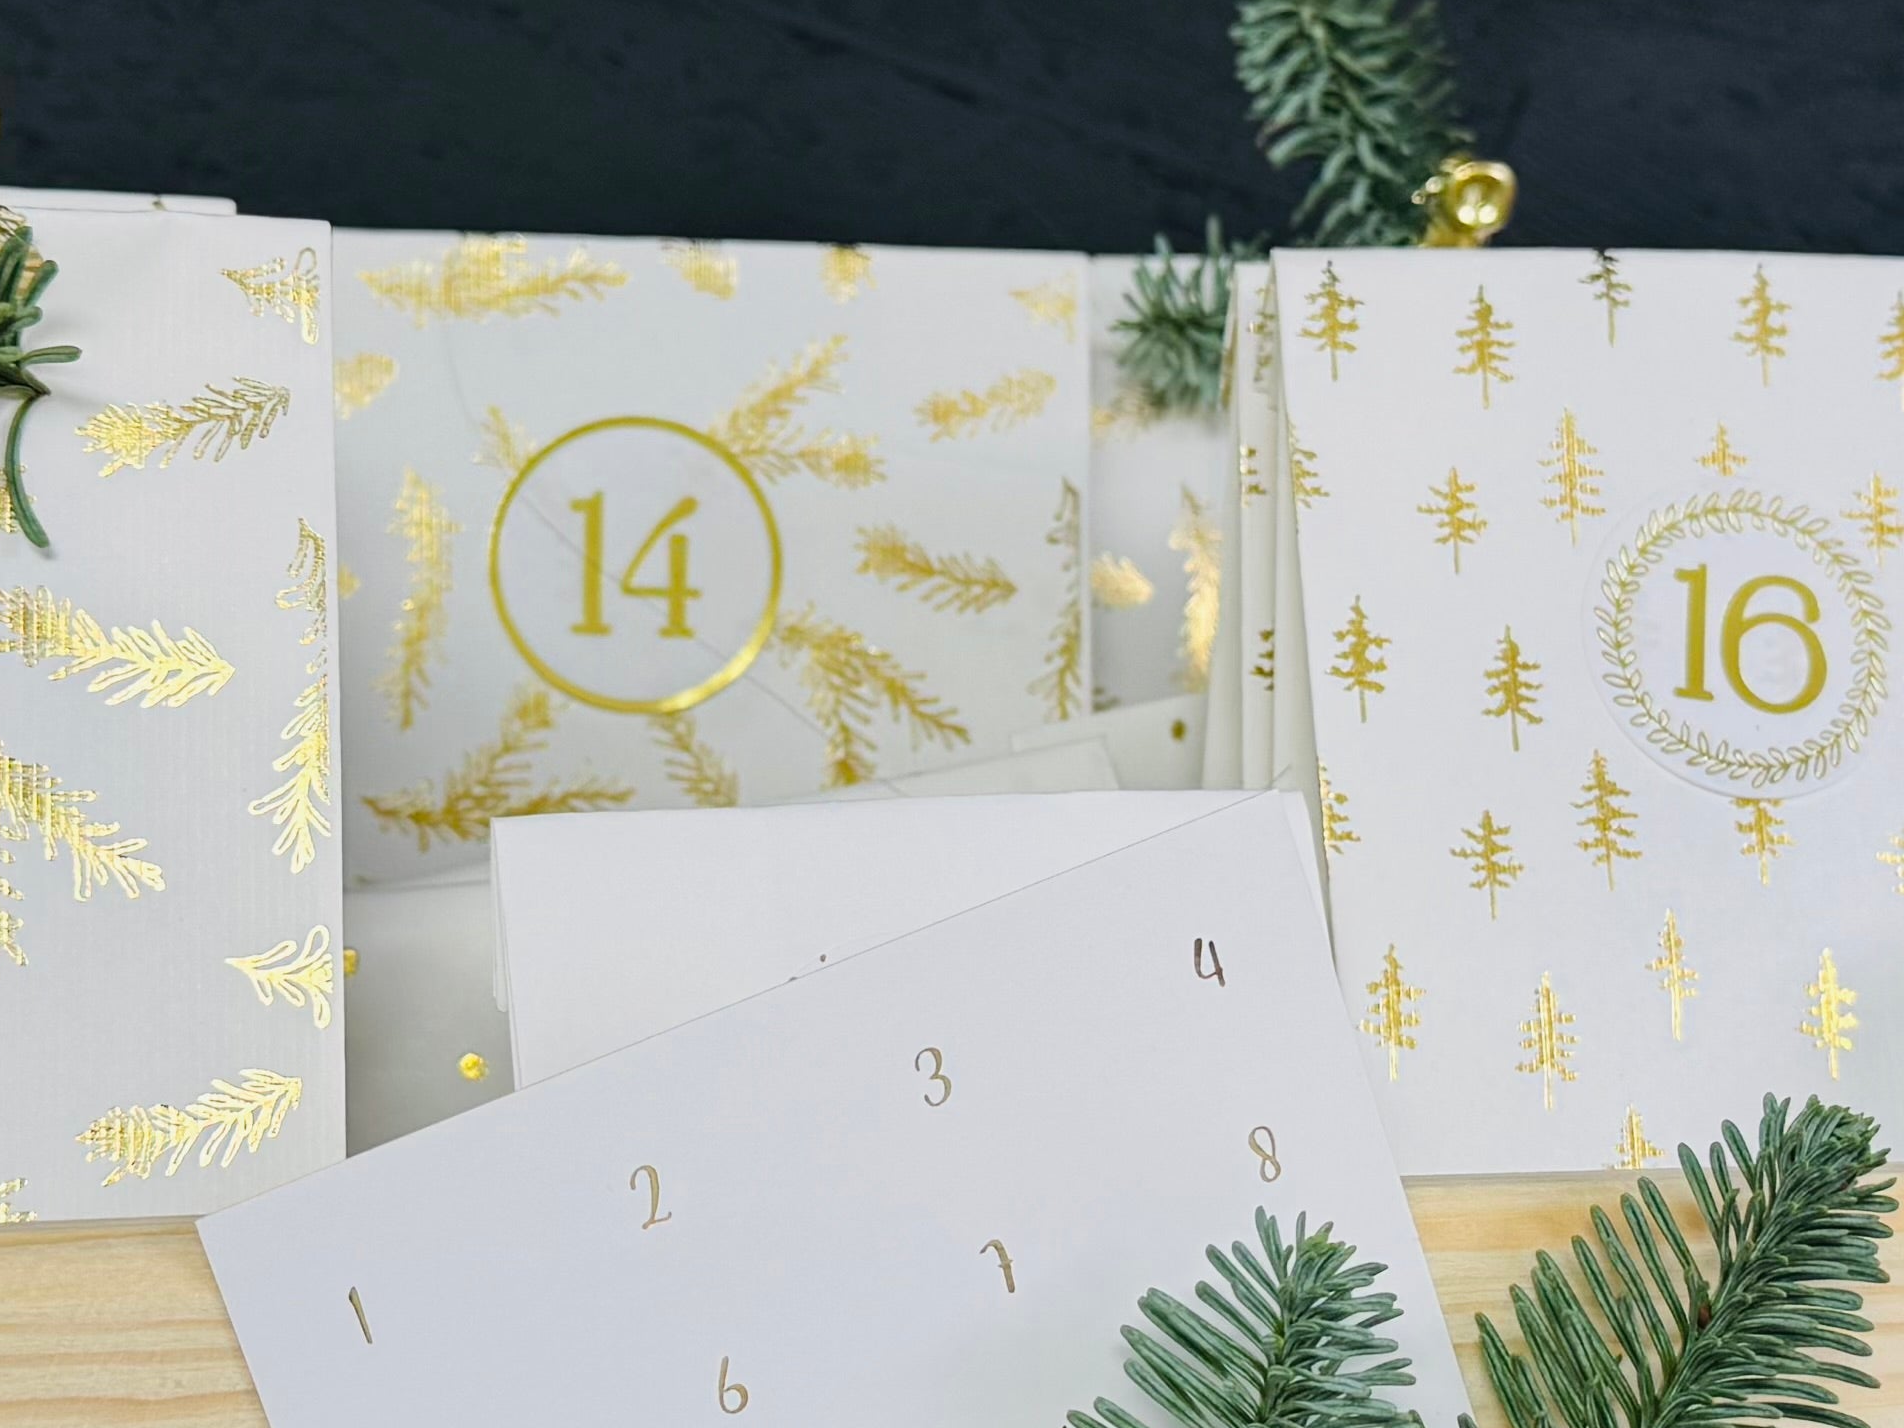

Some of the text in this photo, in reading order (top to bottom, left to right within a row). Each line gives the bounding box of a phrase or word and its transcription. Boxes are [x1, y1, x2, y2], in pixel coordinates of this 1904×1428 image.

[569, 490, 701, 638] 14
[1673, 563, 1827, 714] 16
[1194, 937, 1225, 987] 4
[914, 1047, 953, 1107] 3
[1248, 1126, 1281, 1183] 8
[629, 1164, 672, 1230] 2
[348, 1286, 373, 1345] 1
[718, 1355, 749, 1414] 6
